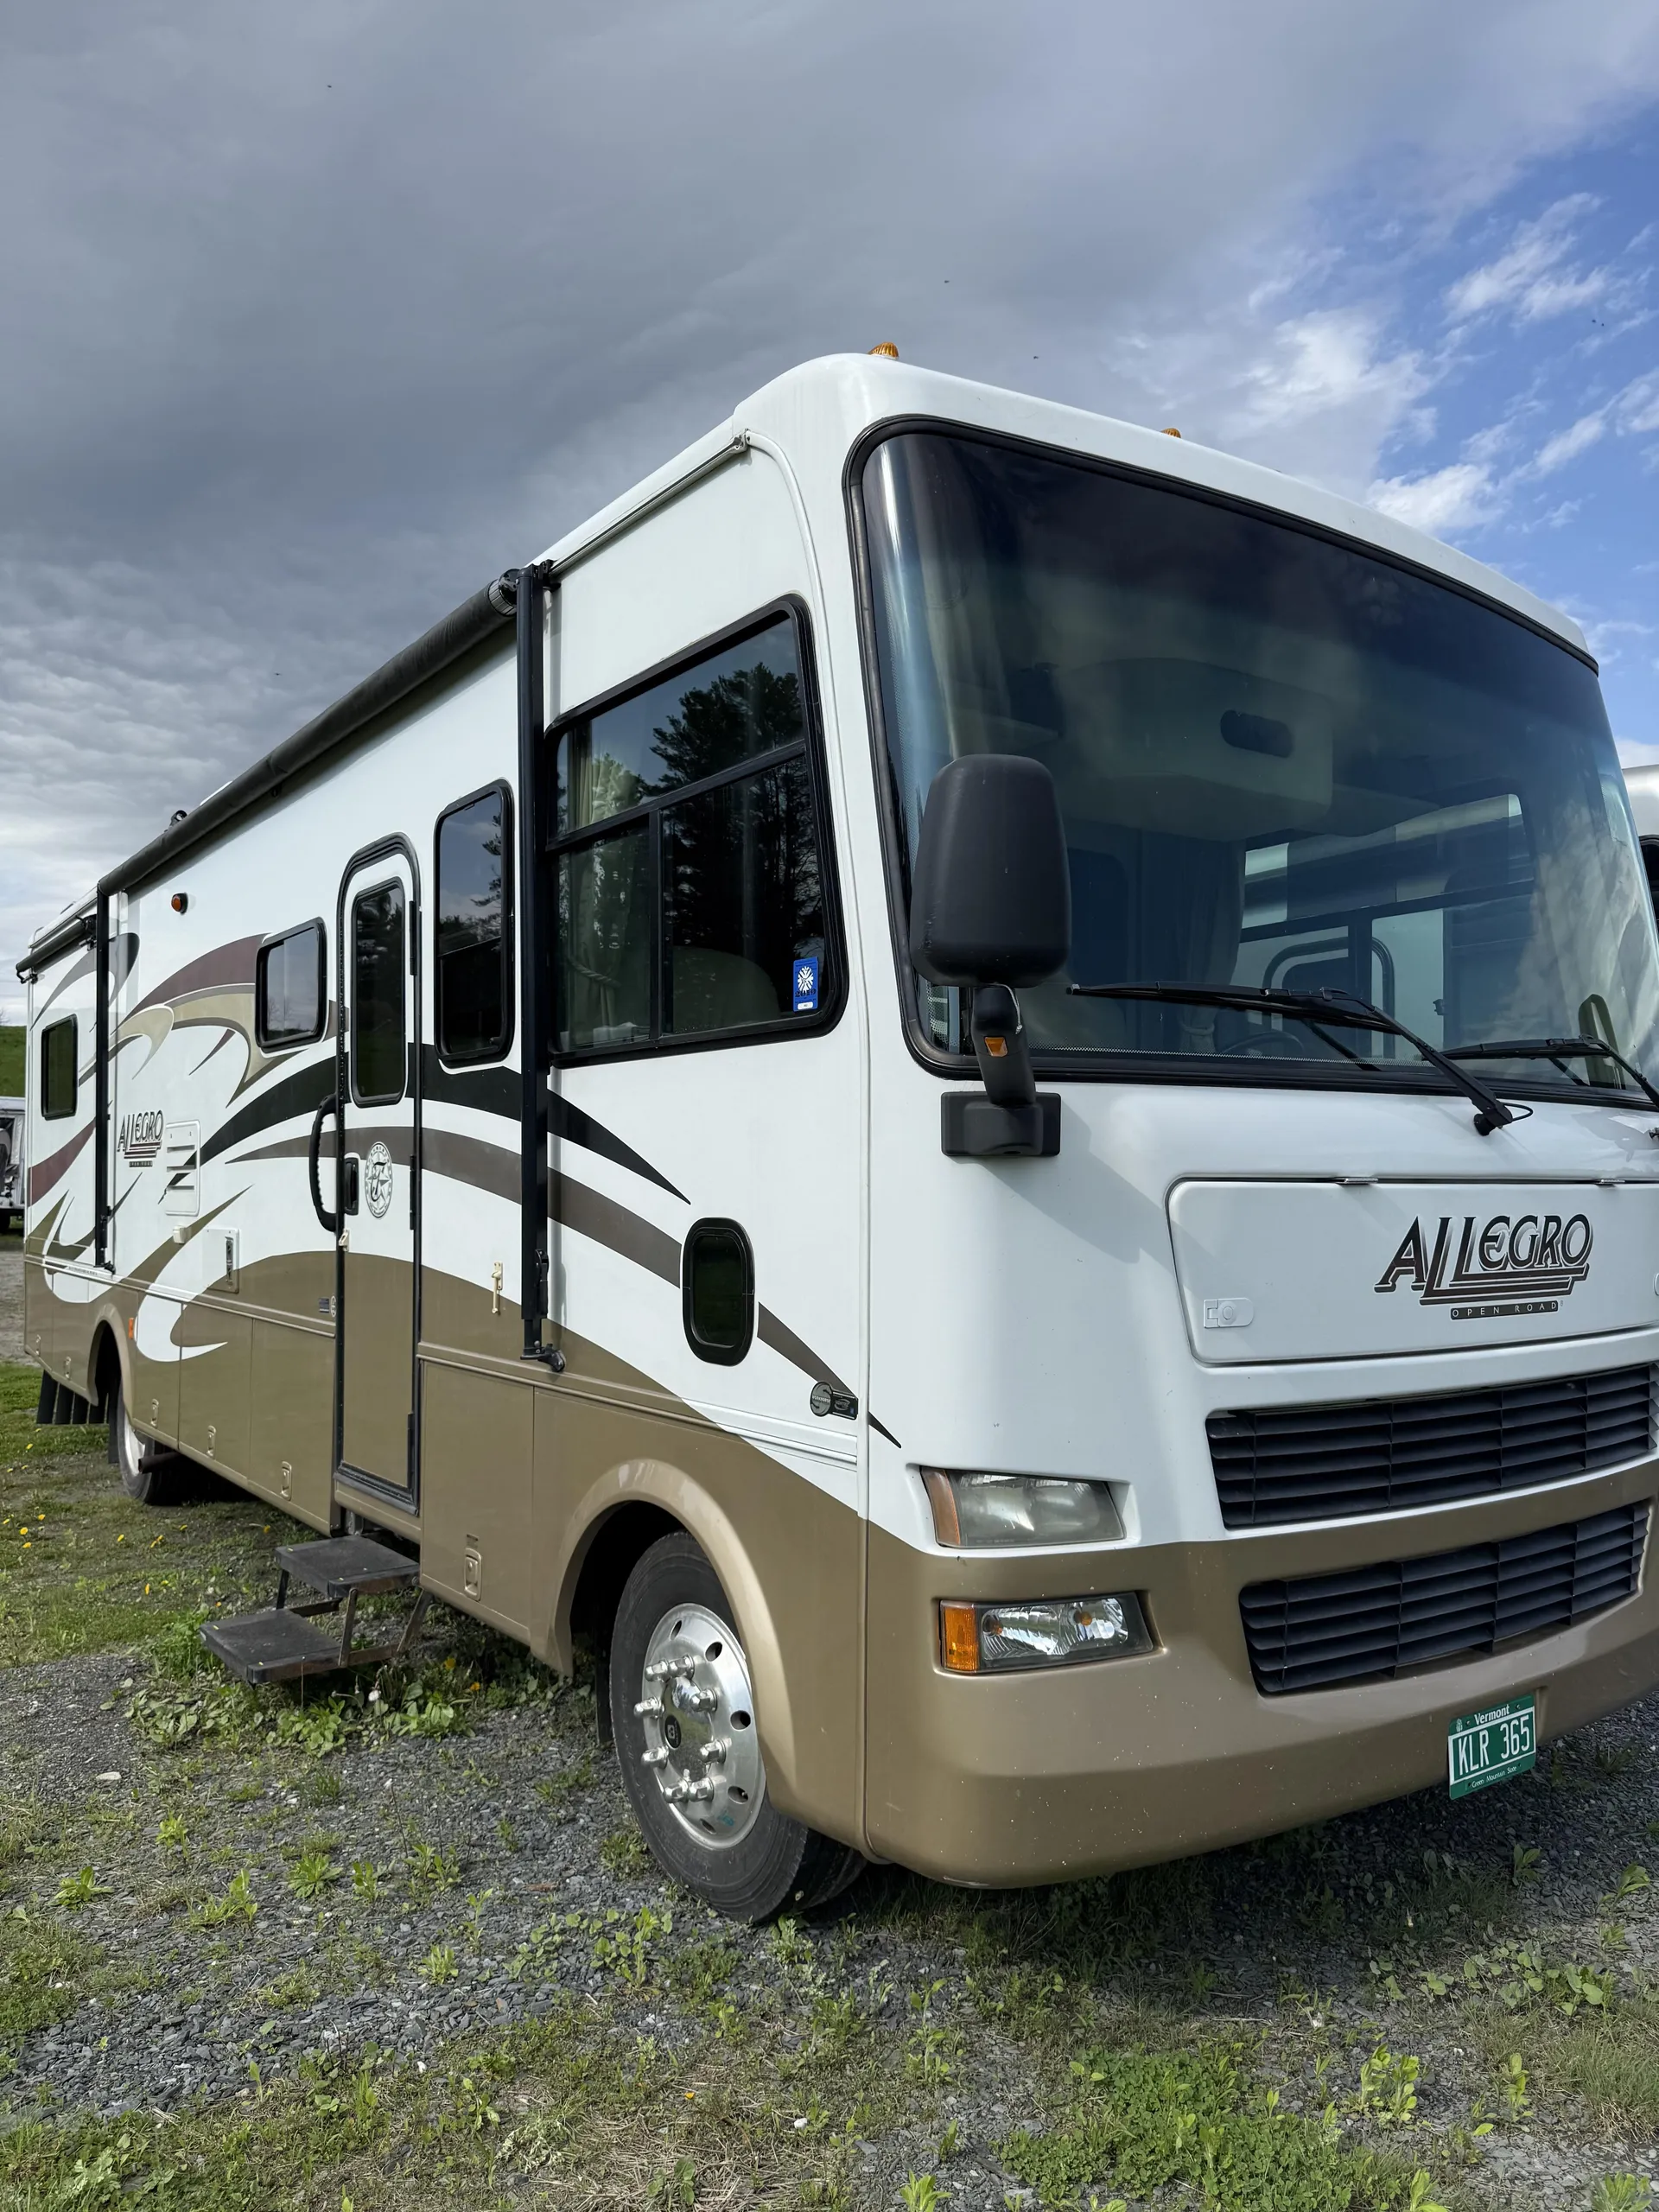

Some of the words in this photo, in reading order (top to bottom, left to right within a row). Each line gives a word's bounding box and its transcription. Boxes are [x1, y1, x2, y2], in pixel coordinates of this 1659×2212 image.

[117, 1109, 163, 1159] ALLEGRO
[1374, 1213, 1593, 1306] ALLEGRO
[1452, 1306, 1500, 1318] OPEN
[1515, 1301, 1558, 1313] ROAD
[1474, 1704, 1510, 1726] Vermont
[1458, 1729, 1490, 1776] KLR
[1500, 1715, 1529, 1759] 365
